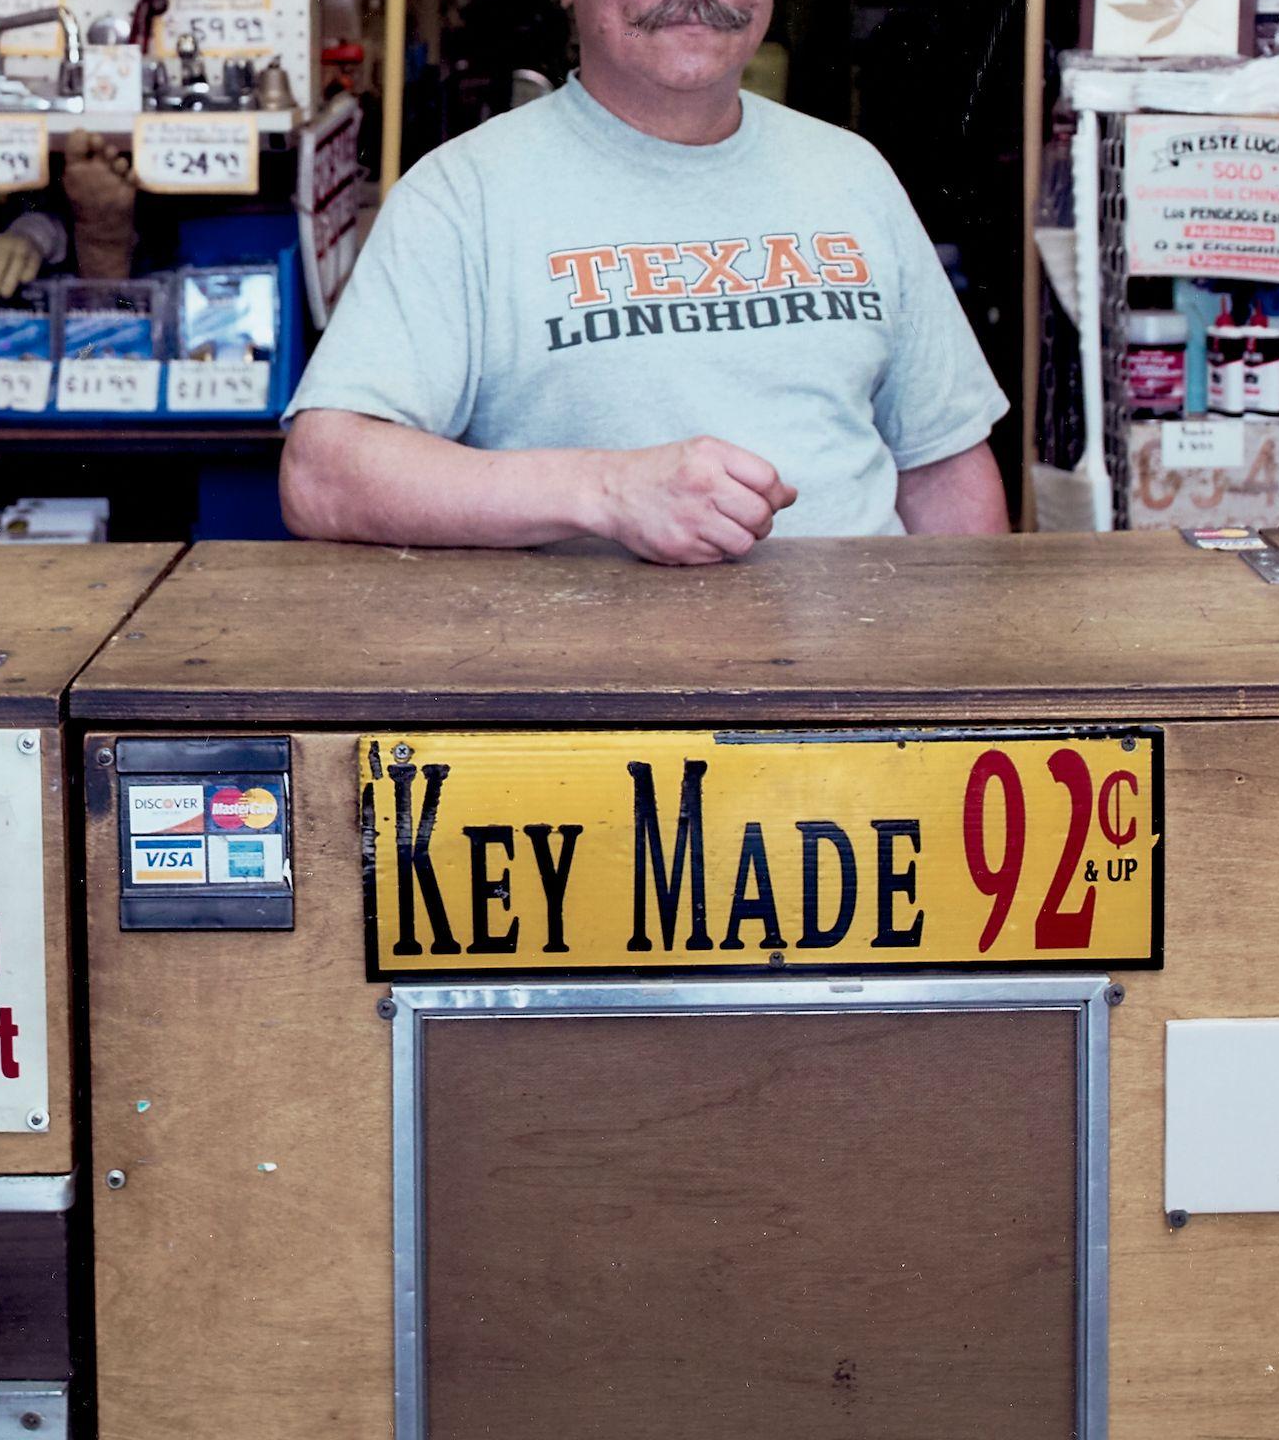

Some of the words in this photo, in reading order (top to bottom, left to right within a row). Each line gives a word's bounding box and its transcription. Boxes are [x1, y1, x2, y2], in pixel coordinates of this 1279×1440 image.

[1171, 137, 1194, 156] EN
[1198, 134, 1239, 152] ESTE
[1212, 161, 1264, 181] SOLO
[546, 230, 876, 310] TEXAS
[545, 289, 884, 352] LONGHORNS
[133, 797, 199, 810] DISCOVER
[145, 851, 194, 868] VISA
[392, 761, 586, 957] KEY
[625, 759, 928, 954] MADE
[1083, 859, 1101, 884] &
[1105, 856, 1140, 885] UP
